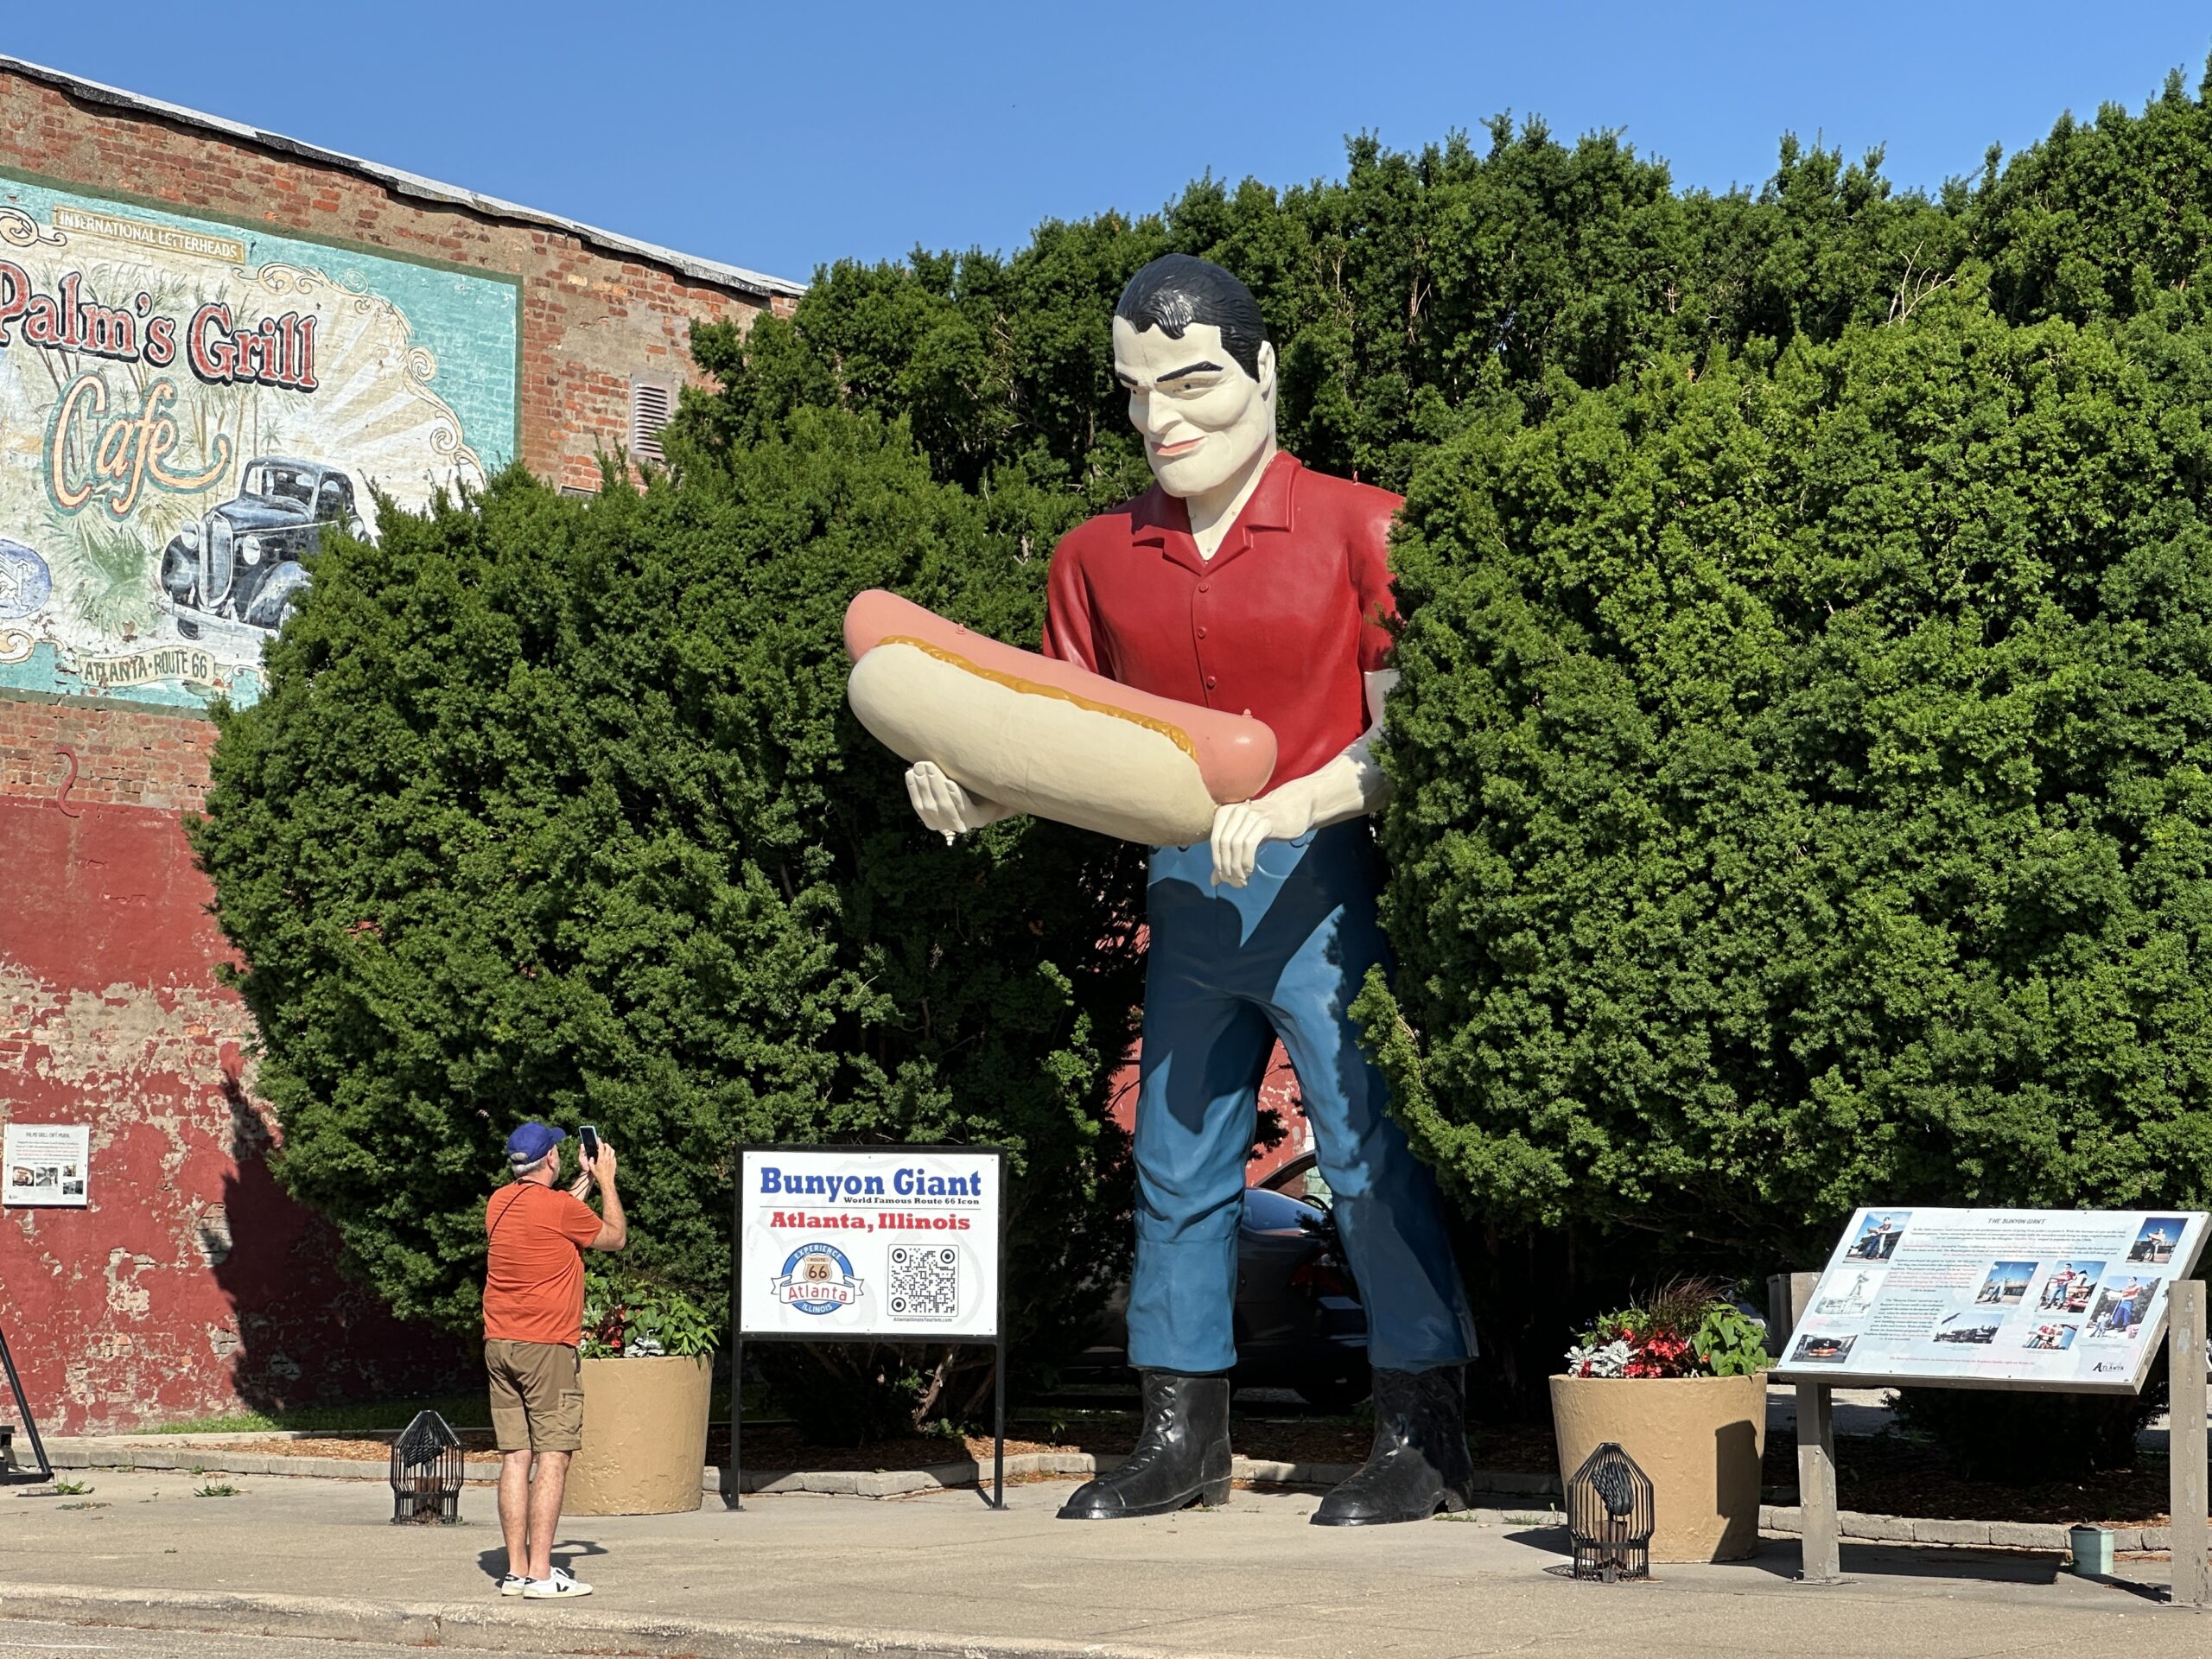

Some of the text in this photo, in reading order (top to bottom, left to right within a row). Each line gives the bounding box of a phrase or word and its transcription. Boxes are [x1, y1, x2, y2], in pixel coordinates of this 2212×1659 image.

[60, 211, 237, 257] INTERNATIONAL LETTERHEADS
[0, 262, 319, 392] Palm's Grill
[44, 370, 230, 521] Cafe
[84, 650, 207, 682] ATLANTA ROUTE 66
[760, 1166, 982, 1203] Bunyon Giant
[770, 1211, 970, 1233] Atlanta, Illinois
[794, 1244, 842, 1260] EXPERIENCE
[809, 1265, 827, 1279] 66
[788, 1285, 848, 1301] Atlanta
[802, 1303, 833, 1313] ILLINOIS
